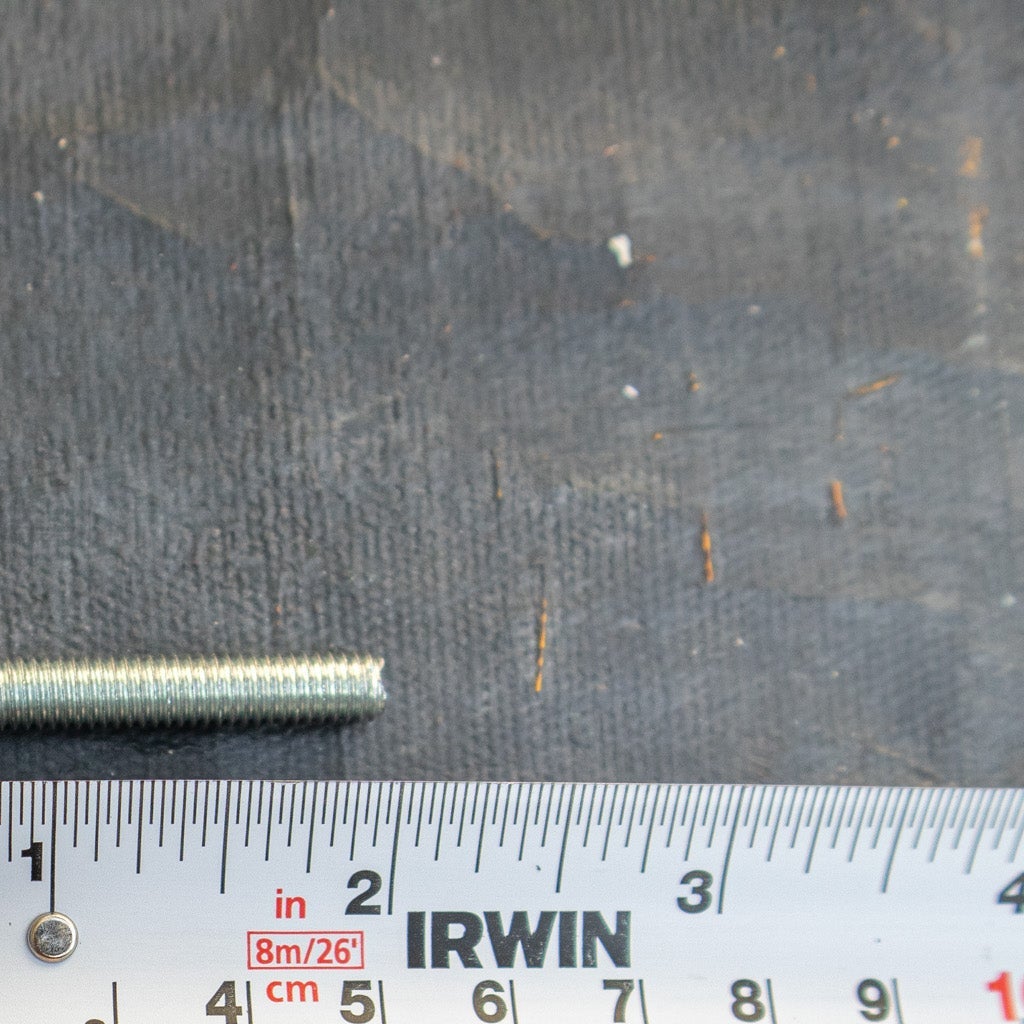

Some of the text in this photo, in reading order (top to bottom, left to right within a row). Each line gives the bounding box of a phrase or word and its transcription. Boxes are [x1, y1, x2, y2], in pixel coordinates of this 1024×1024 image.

[21, 842, 43, 881] 1
[345, 870, 382, 915] 2
[676, 870, 715, 914] 3
[275, 889, 306, 919] in
[406, 911, 631, 969] IRWIN
[206, 980, 243, 1024] 4
[340, 980, 376, 1024] 5
[472, 980, 508, 1024] 6
[602, 980, 636, 1024] 7
[730, 979, 766, 1023] 8
[856, 978, 891, 1022] 9
[266, 980, 319, 1003] cm
